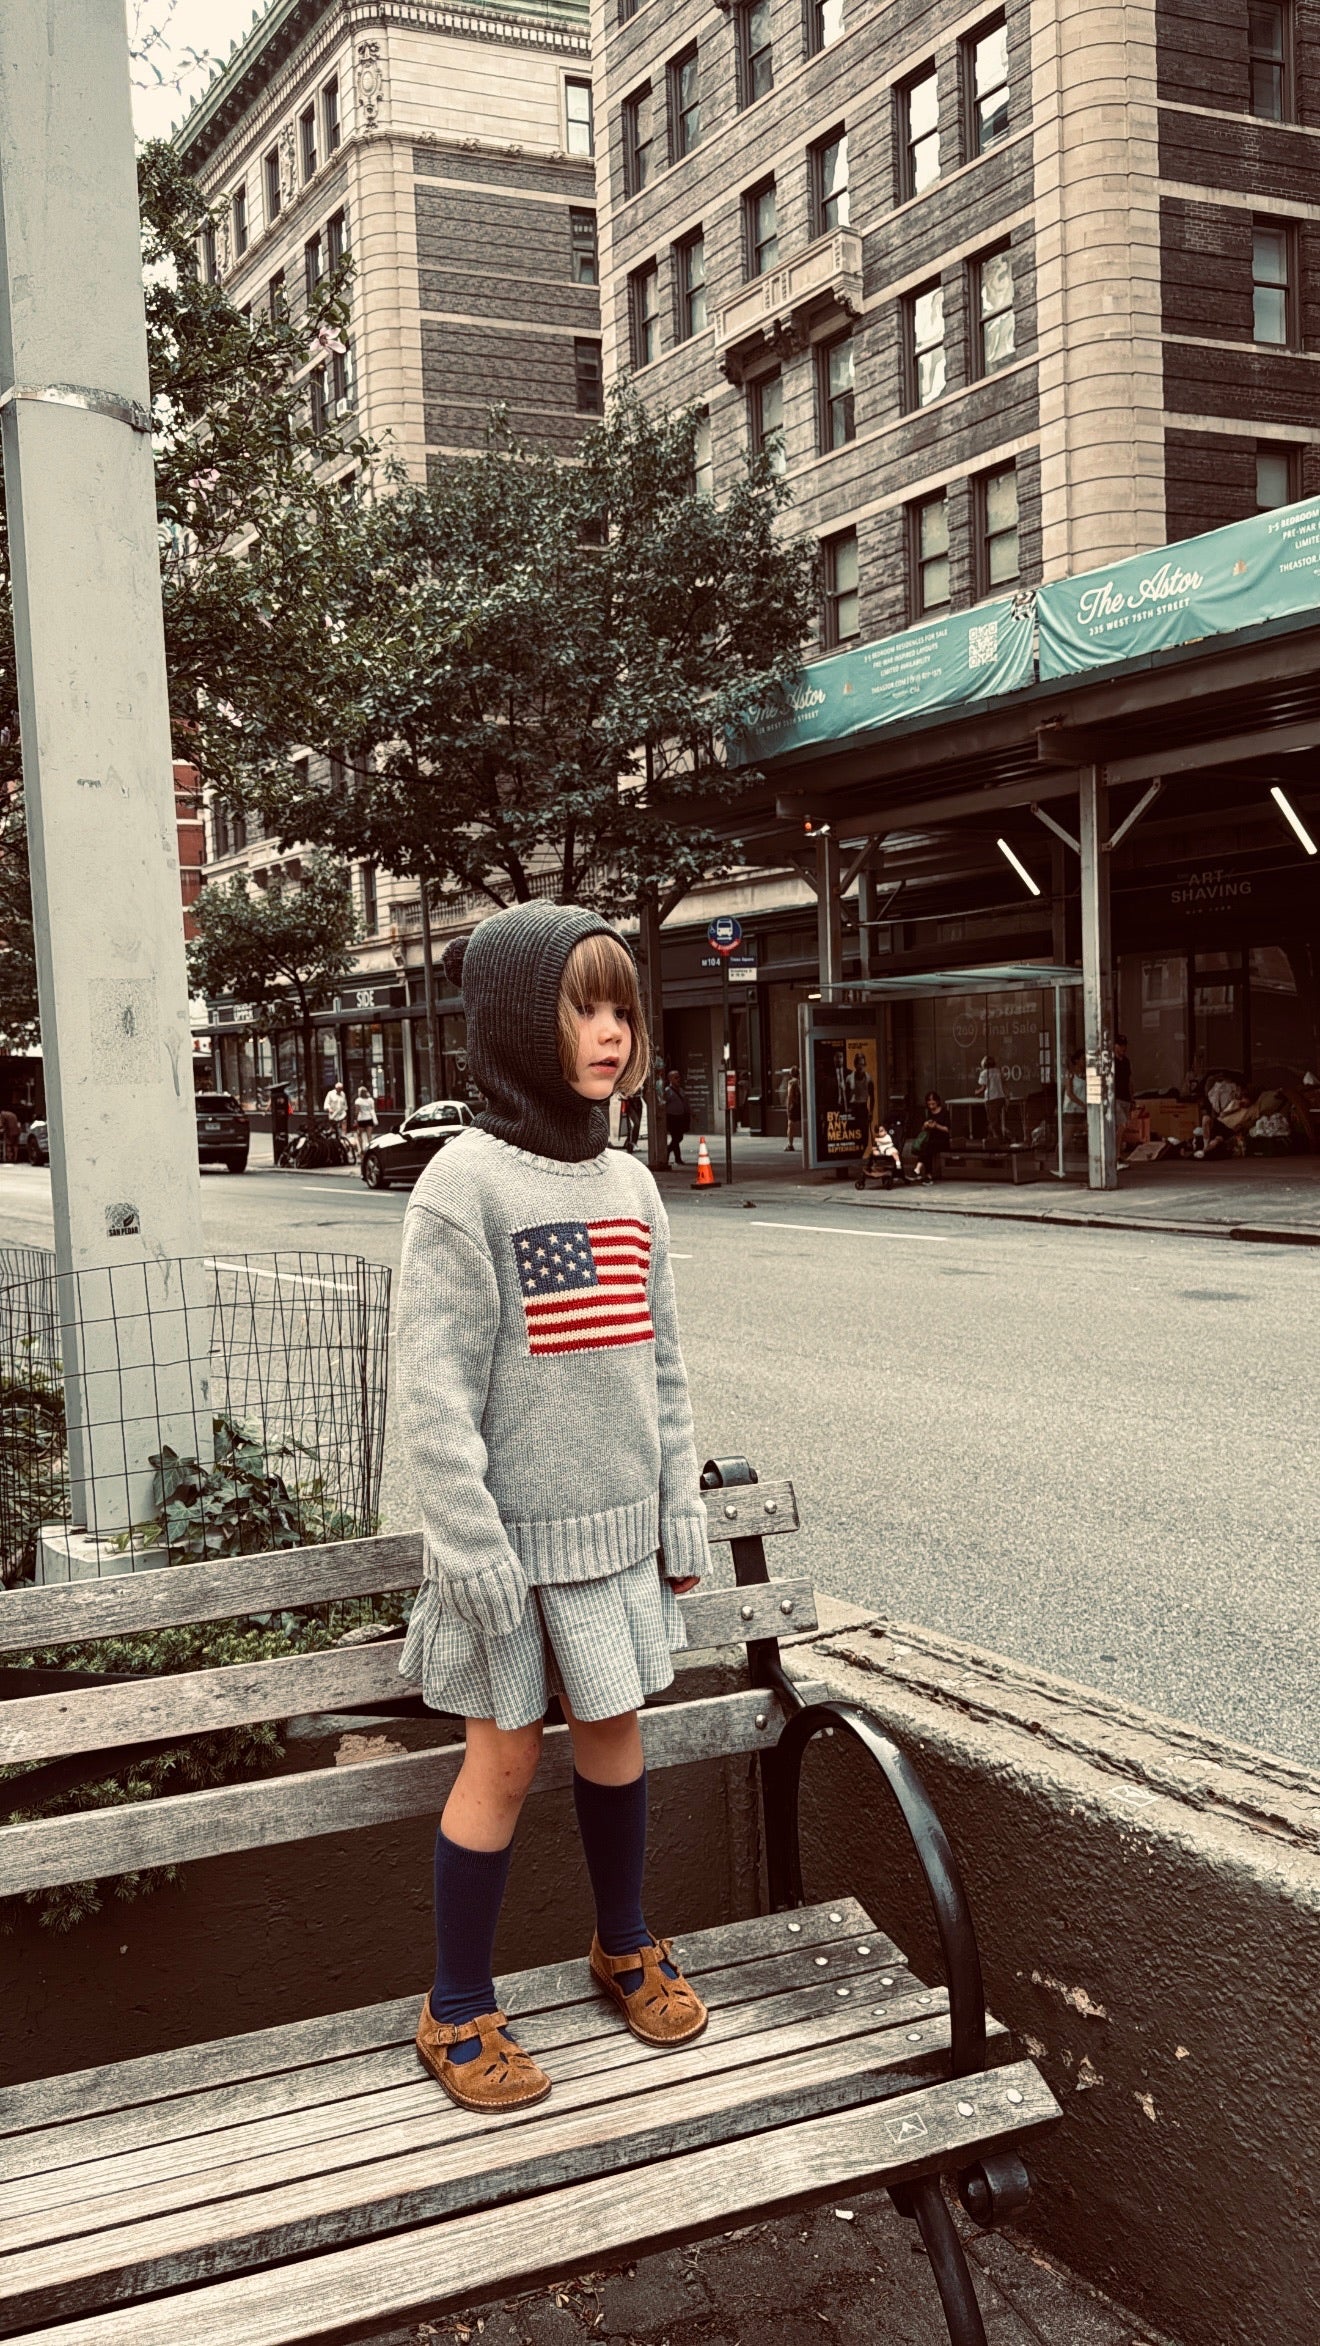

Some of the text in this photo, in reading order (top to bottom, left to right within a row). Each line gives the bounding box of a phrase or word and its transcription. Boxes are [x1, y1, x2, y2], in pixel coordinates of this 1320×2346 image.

[1268, 521, 1280, 534] 3-5
[1282, 522, 1317, 540] PRE-WAR
[1077, 562, 1204, 625] The Astor
[1106, 616, 1130, 631] WEST
[1156, 597, 1191, 616] STREET
[1188, 869, 1225, 887] ART
[1171, 881, 1252, 904] SHAVING
[702, 958, 720, 967] M104
[356, 990, 375, 1007] SIDE
[982, 1021, 1009, 1036] Final
[827, 1111, 840, 1121] BY
[828, 1120, 847, 1131] ANY
[828, 1129, 862, 1141] MEANS
[109, 1228, 120, 1237] SAN
